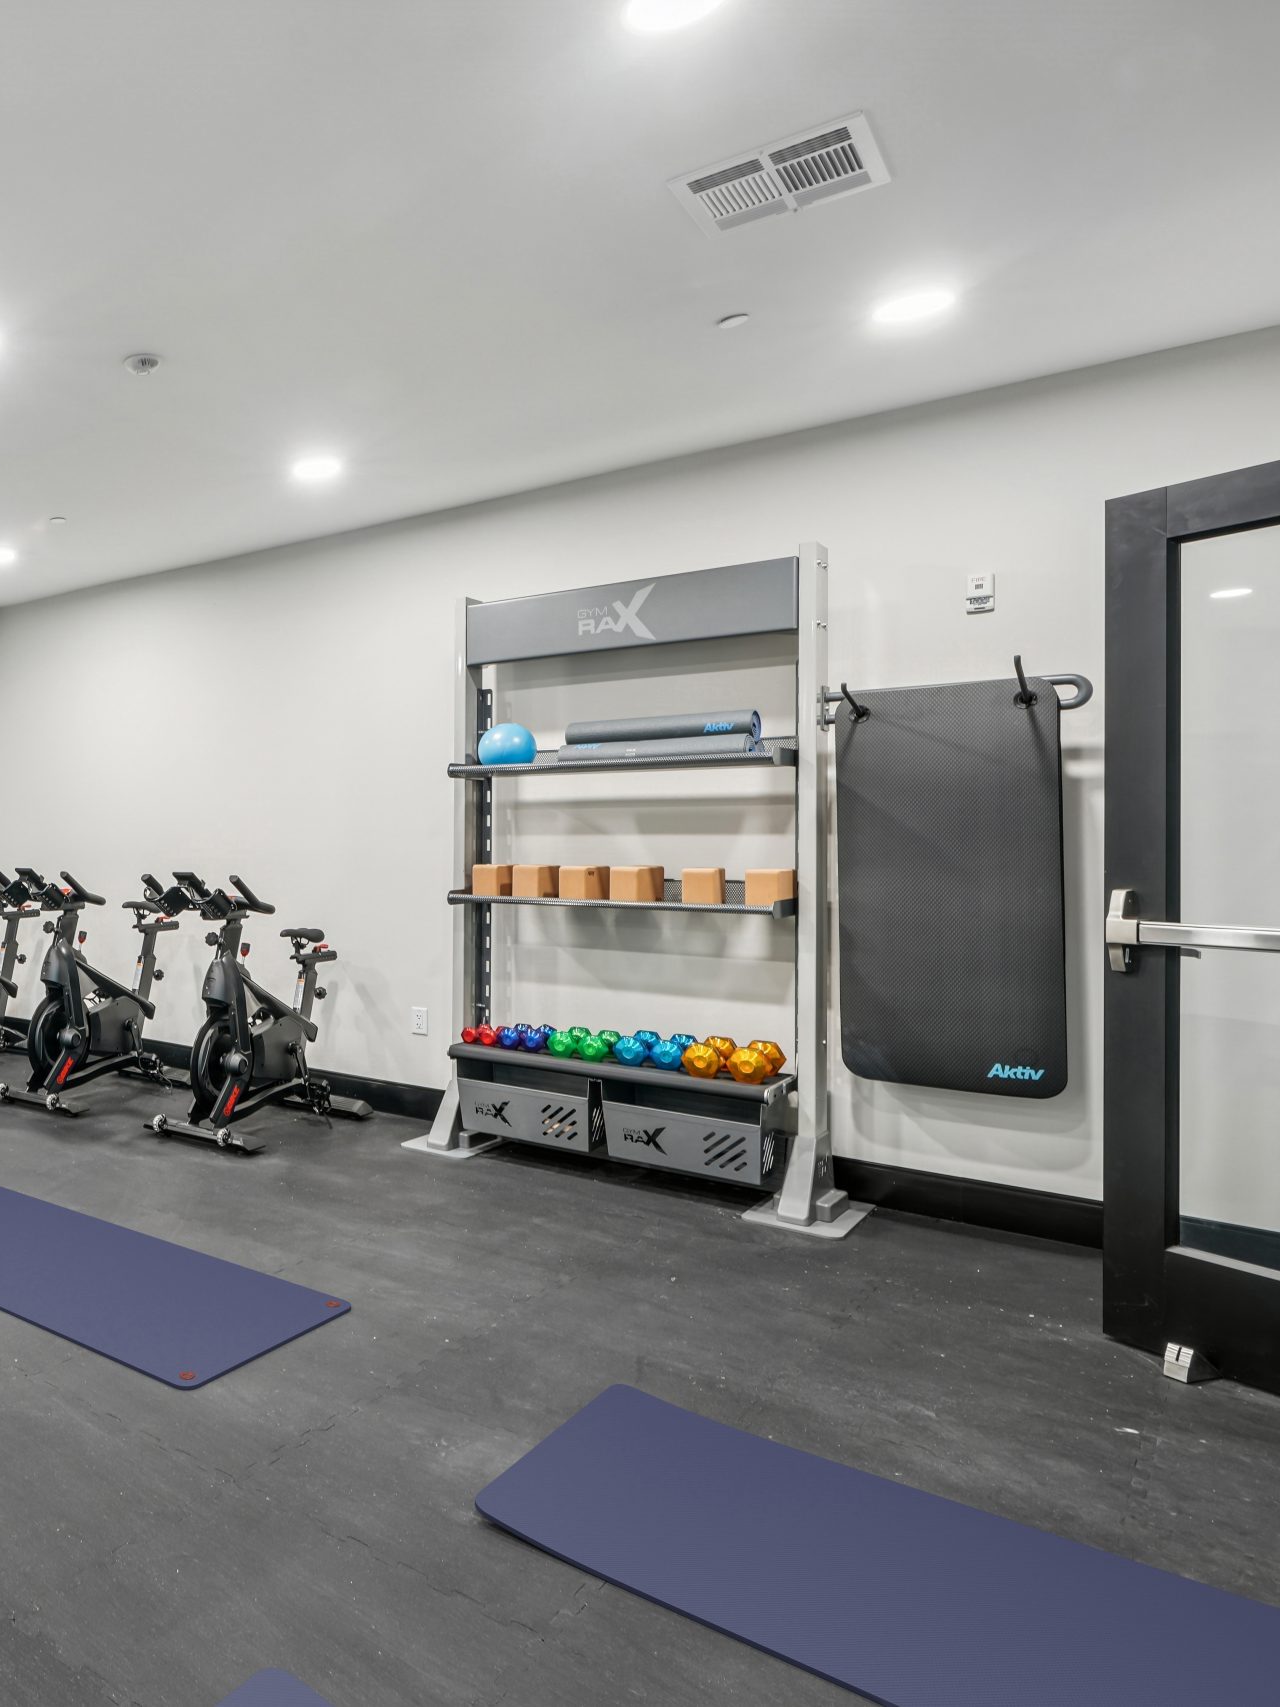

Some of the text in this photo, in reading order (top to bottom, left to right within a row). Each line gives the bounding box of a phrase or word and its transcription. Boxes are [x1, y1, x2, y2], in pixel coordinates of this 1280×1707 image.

[577, 582, 656, 640] RAX
[577, 606, 608, 618] GYM
[703, 721, 736, 733] Aktiv
[986, 1063, 1045, 1080] Aktiv
